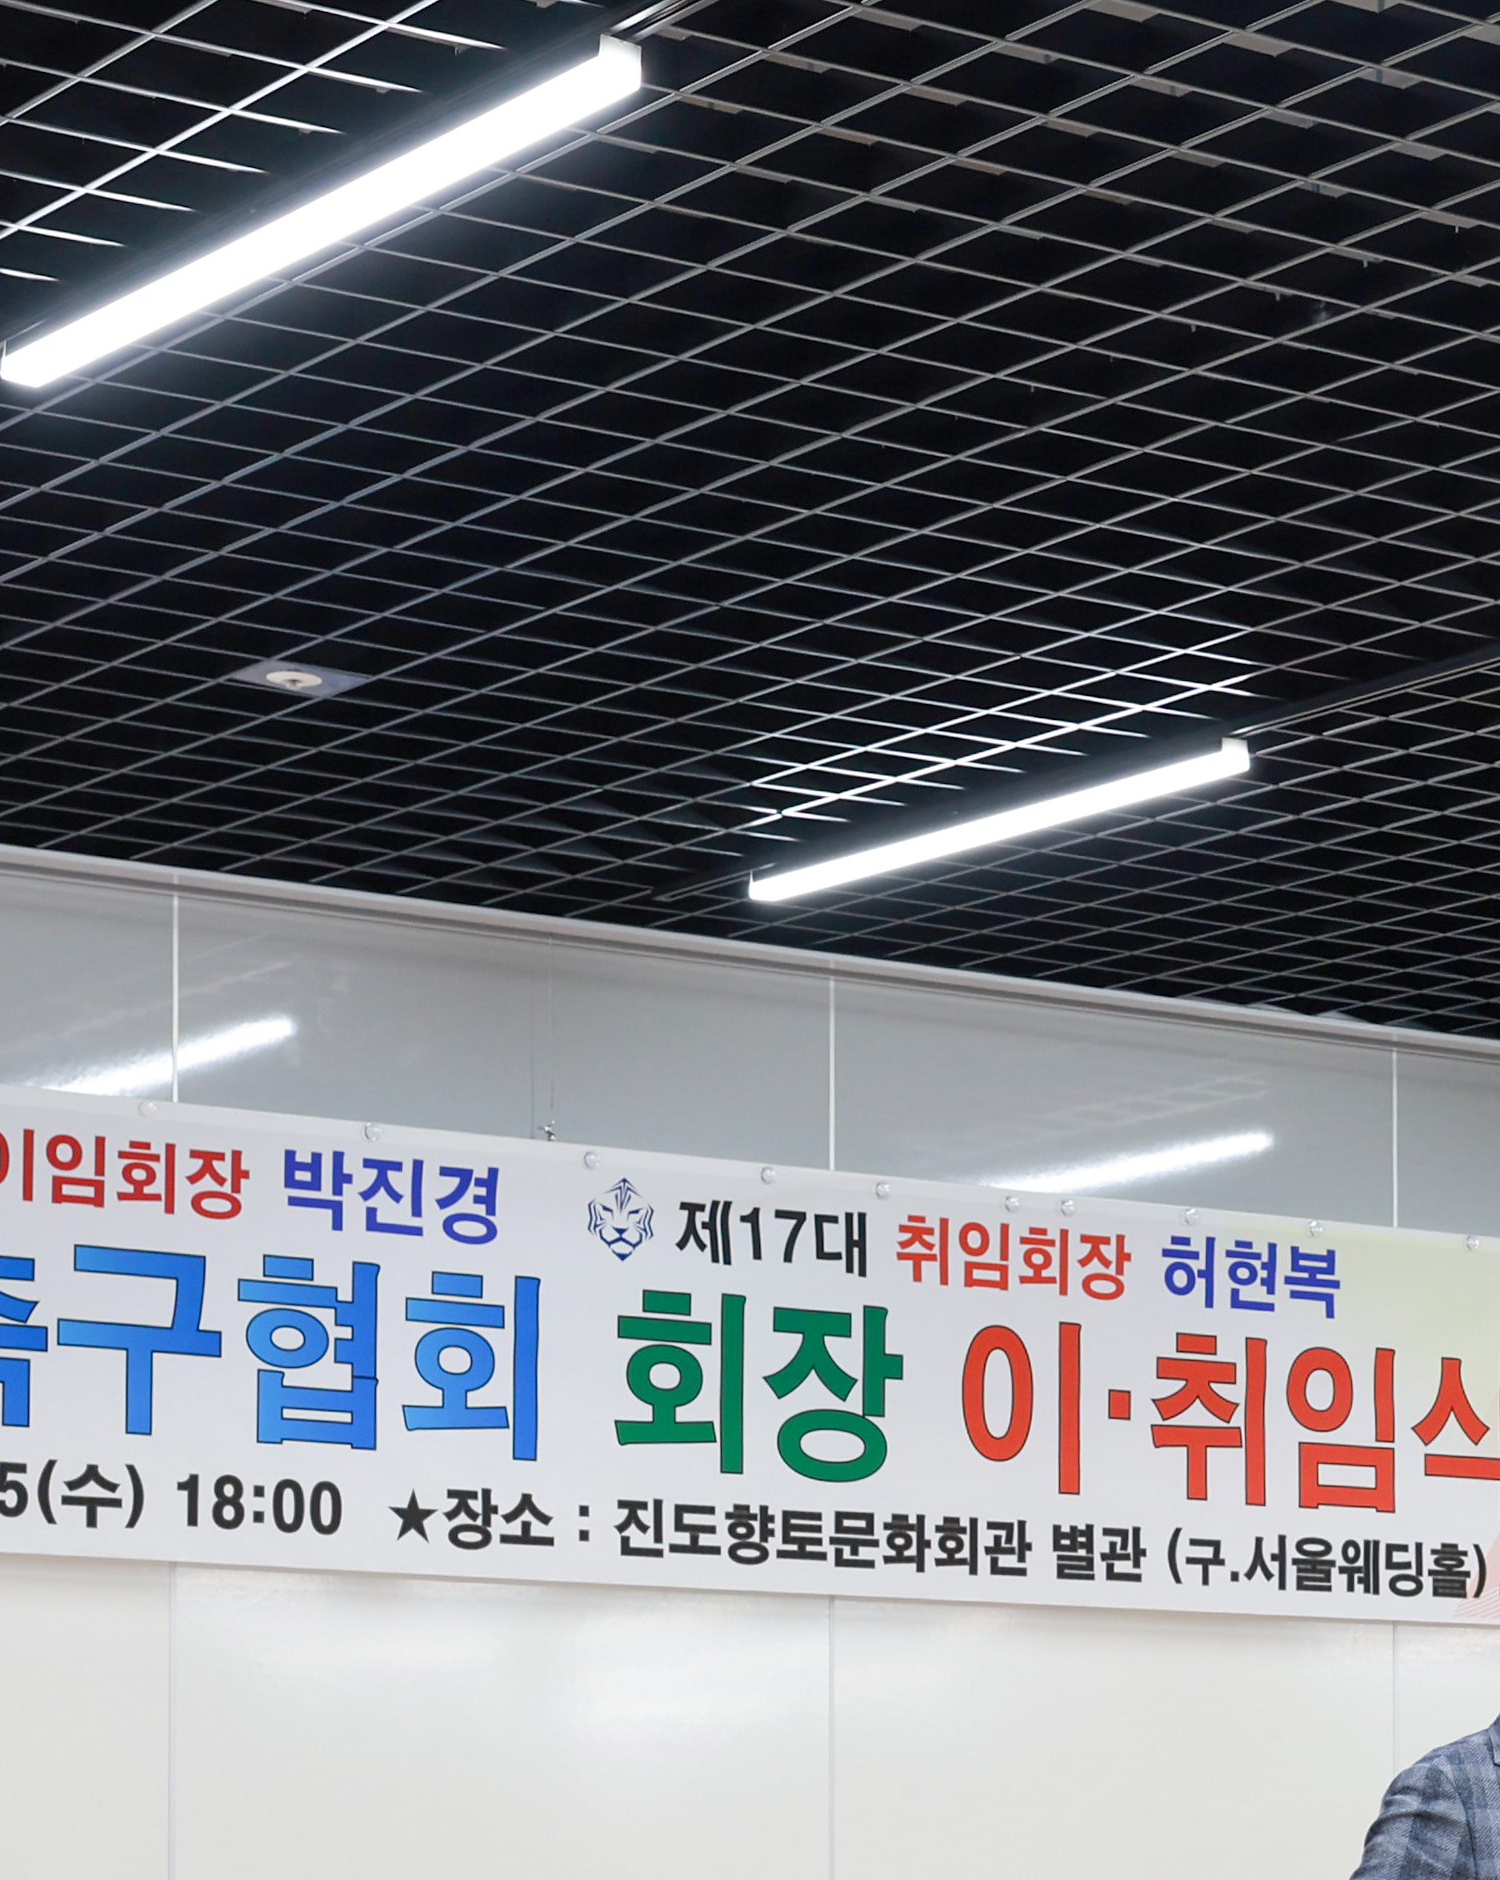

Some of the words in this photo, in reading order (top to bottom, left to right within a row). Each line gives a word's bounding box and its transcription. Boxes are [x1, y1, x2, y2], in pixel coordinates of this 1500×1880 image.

[282, 1148, 501, 1245] 박진경
[675, 1199, 868, 1278] 제17대
[895, 1213, 1132, 1301] 취임회장
[1160, 1233, 1341, 1319] 허현복
[613, 1289, 904, 1483] 회장
[175, 1472, 343, 1535] 18:00
[613, 1497, 1033, 1577] 진도향토문화회관
[1050, 1521, 1147, 1582] 별관
[1165, 1526, 1487, 1600] (구.서울웨딩홀)
